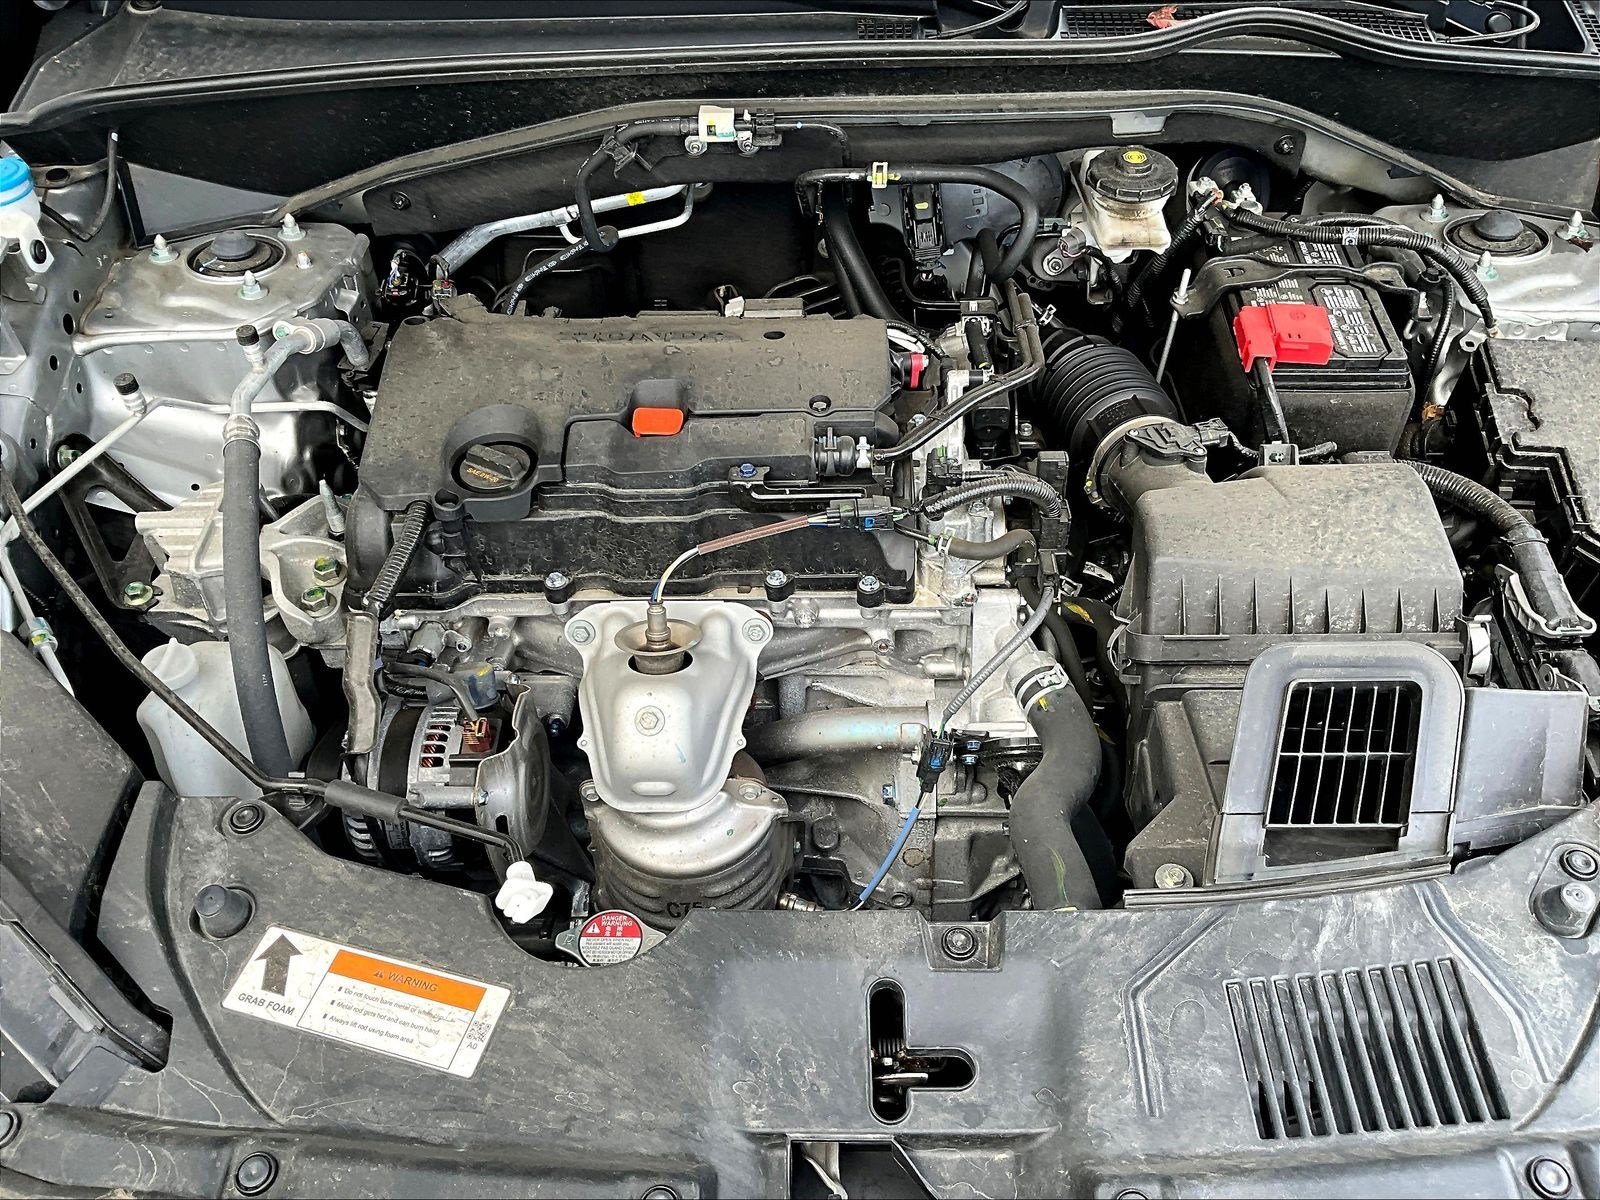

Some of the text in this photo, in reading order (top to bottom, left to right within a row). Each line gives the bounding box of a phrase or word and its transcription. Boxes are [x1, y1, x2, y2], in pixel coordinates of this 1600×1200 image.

[388, 971, 439, 992] WARNING
[238, 992, 296, 1016] GRAB FOAM
[344, 987, 352, 996] Do
[364, 994, 380, 1004] touch
[380, 997, 393, 1006] bare
[394, 1001, 411, 1010] metal
[328, 1016, 349, 1025] Always
[368, 1026, 384, 1037] using
[384, 1030, 400, 1040] foam
[400, 1035, 414, 1044] area
[336, 1002, 352, 1011] Metal
[352, 1006, 364, 1014] rod
[364, 1010, 376, 1018] gets
[424, 1026, 440, 1035] hand
